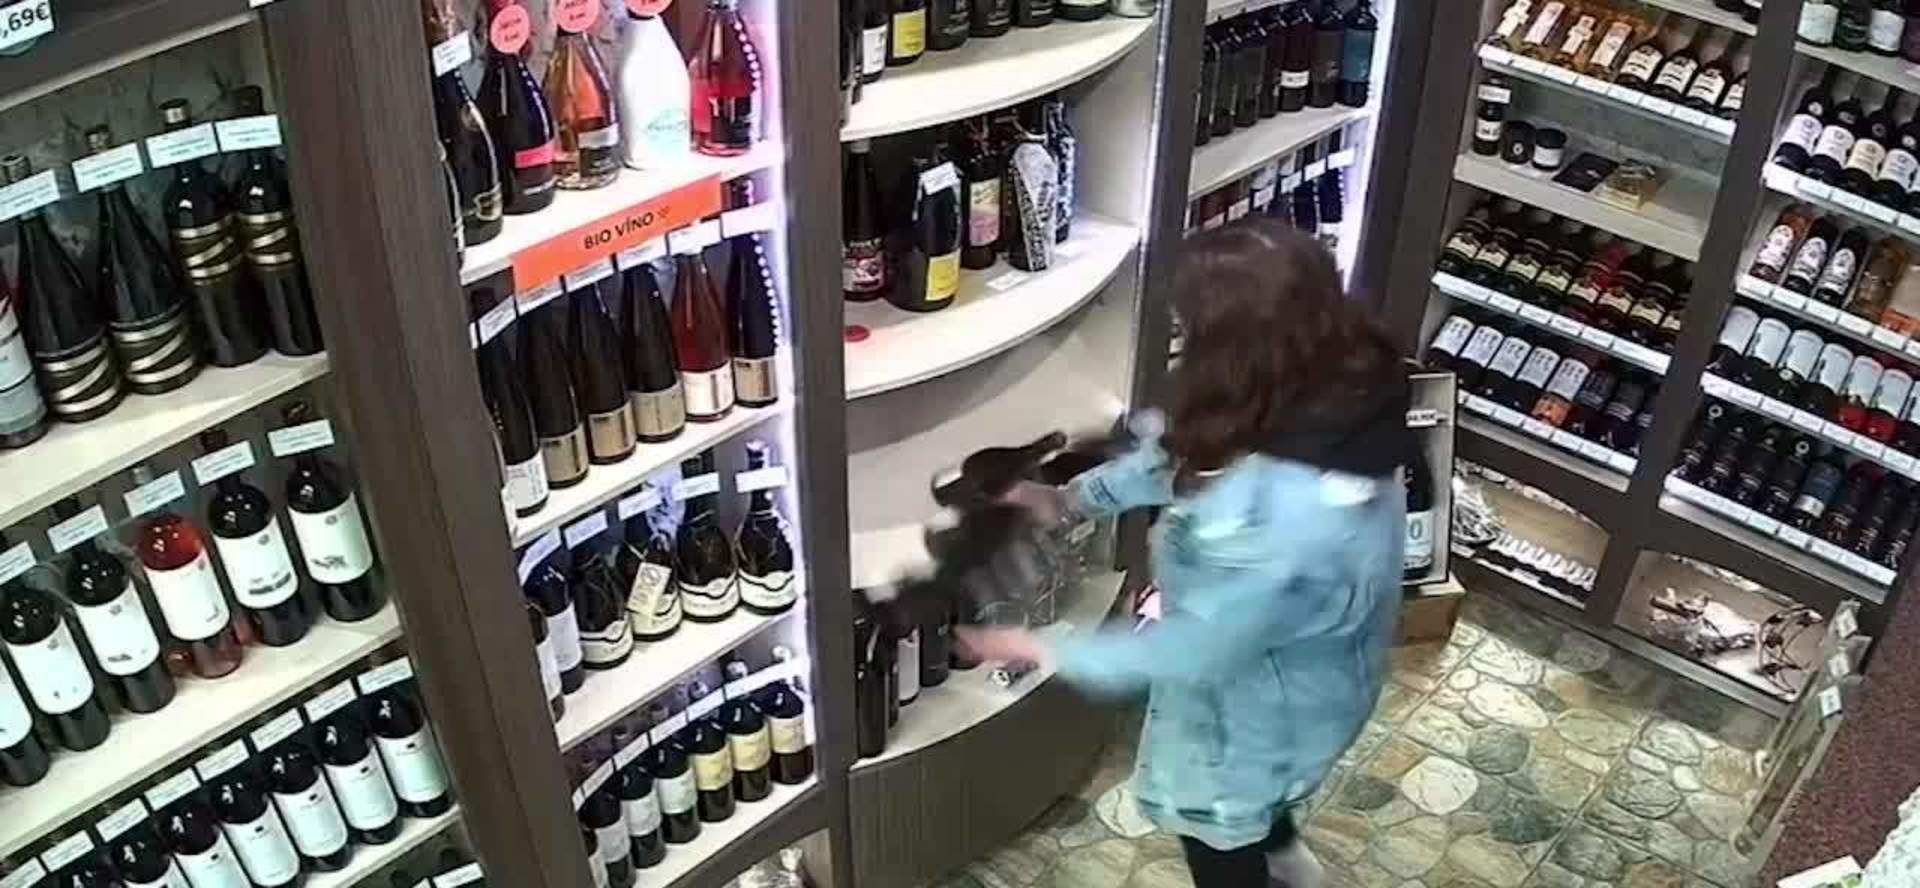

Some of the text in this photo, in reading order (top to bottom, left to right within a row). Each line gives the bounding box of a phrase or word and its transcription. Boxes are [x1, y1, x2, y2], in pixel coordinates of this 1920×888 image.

[0, 2, 49, 38] ,69€
[584, 212, 654, 250] BIO VÍNO
